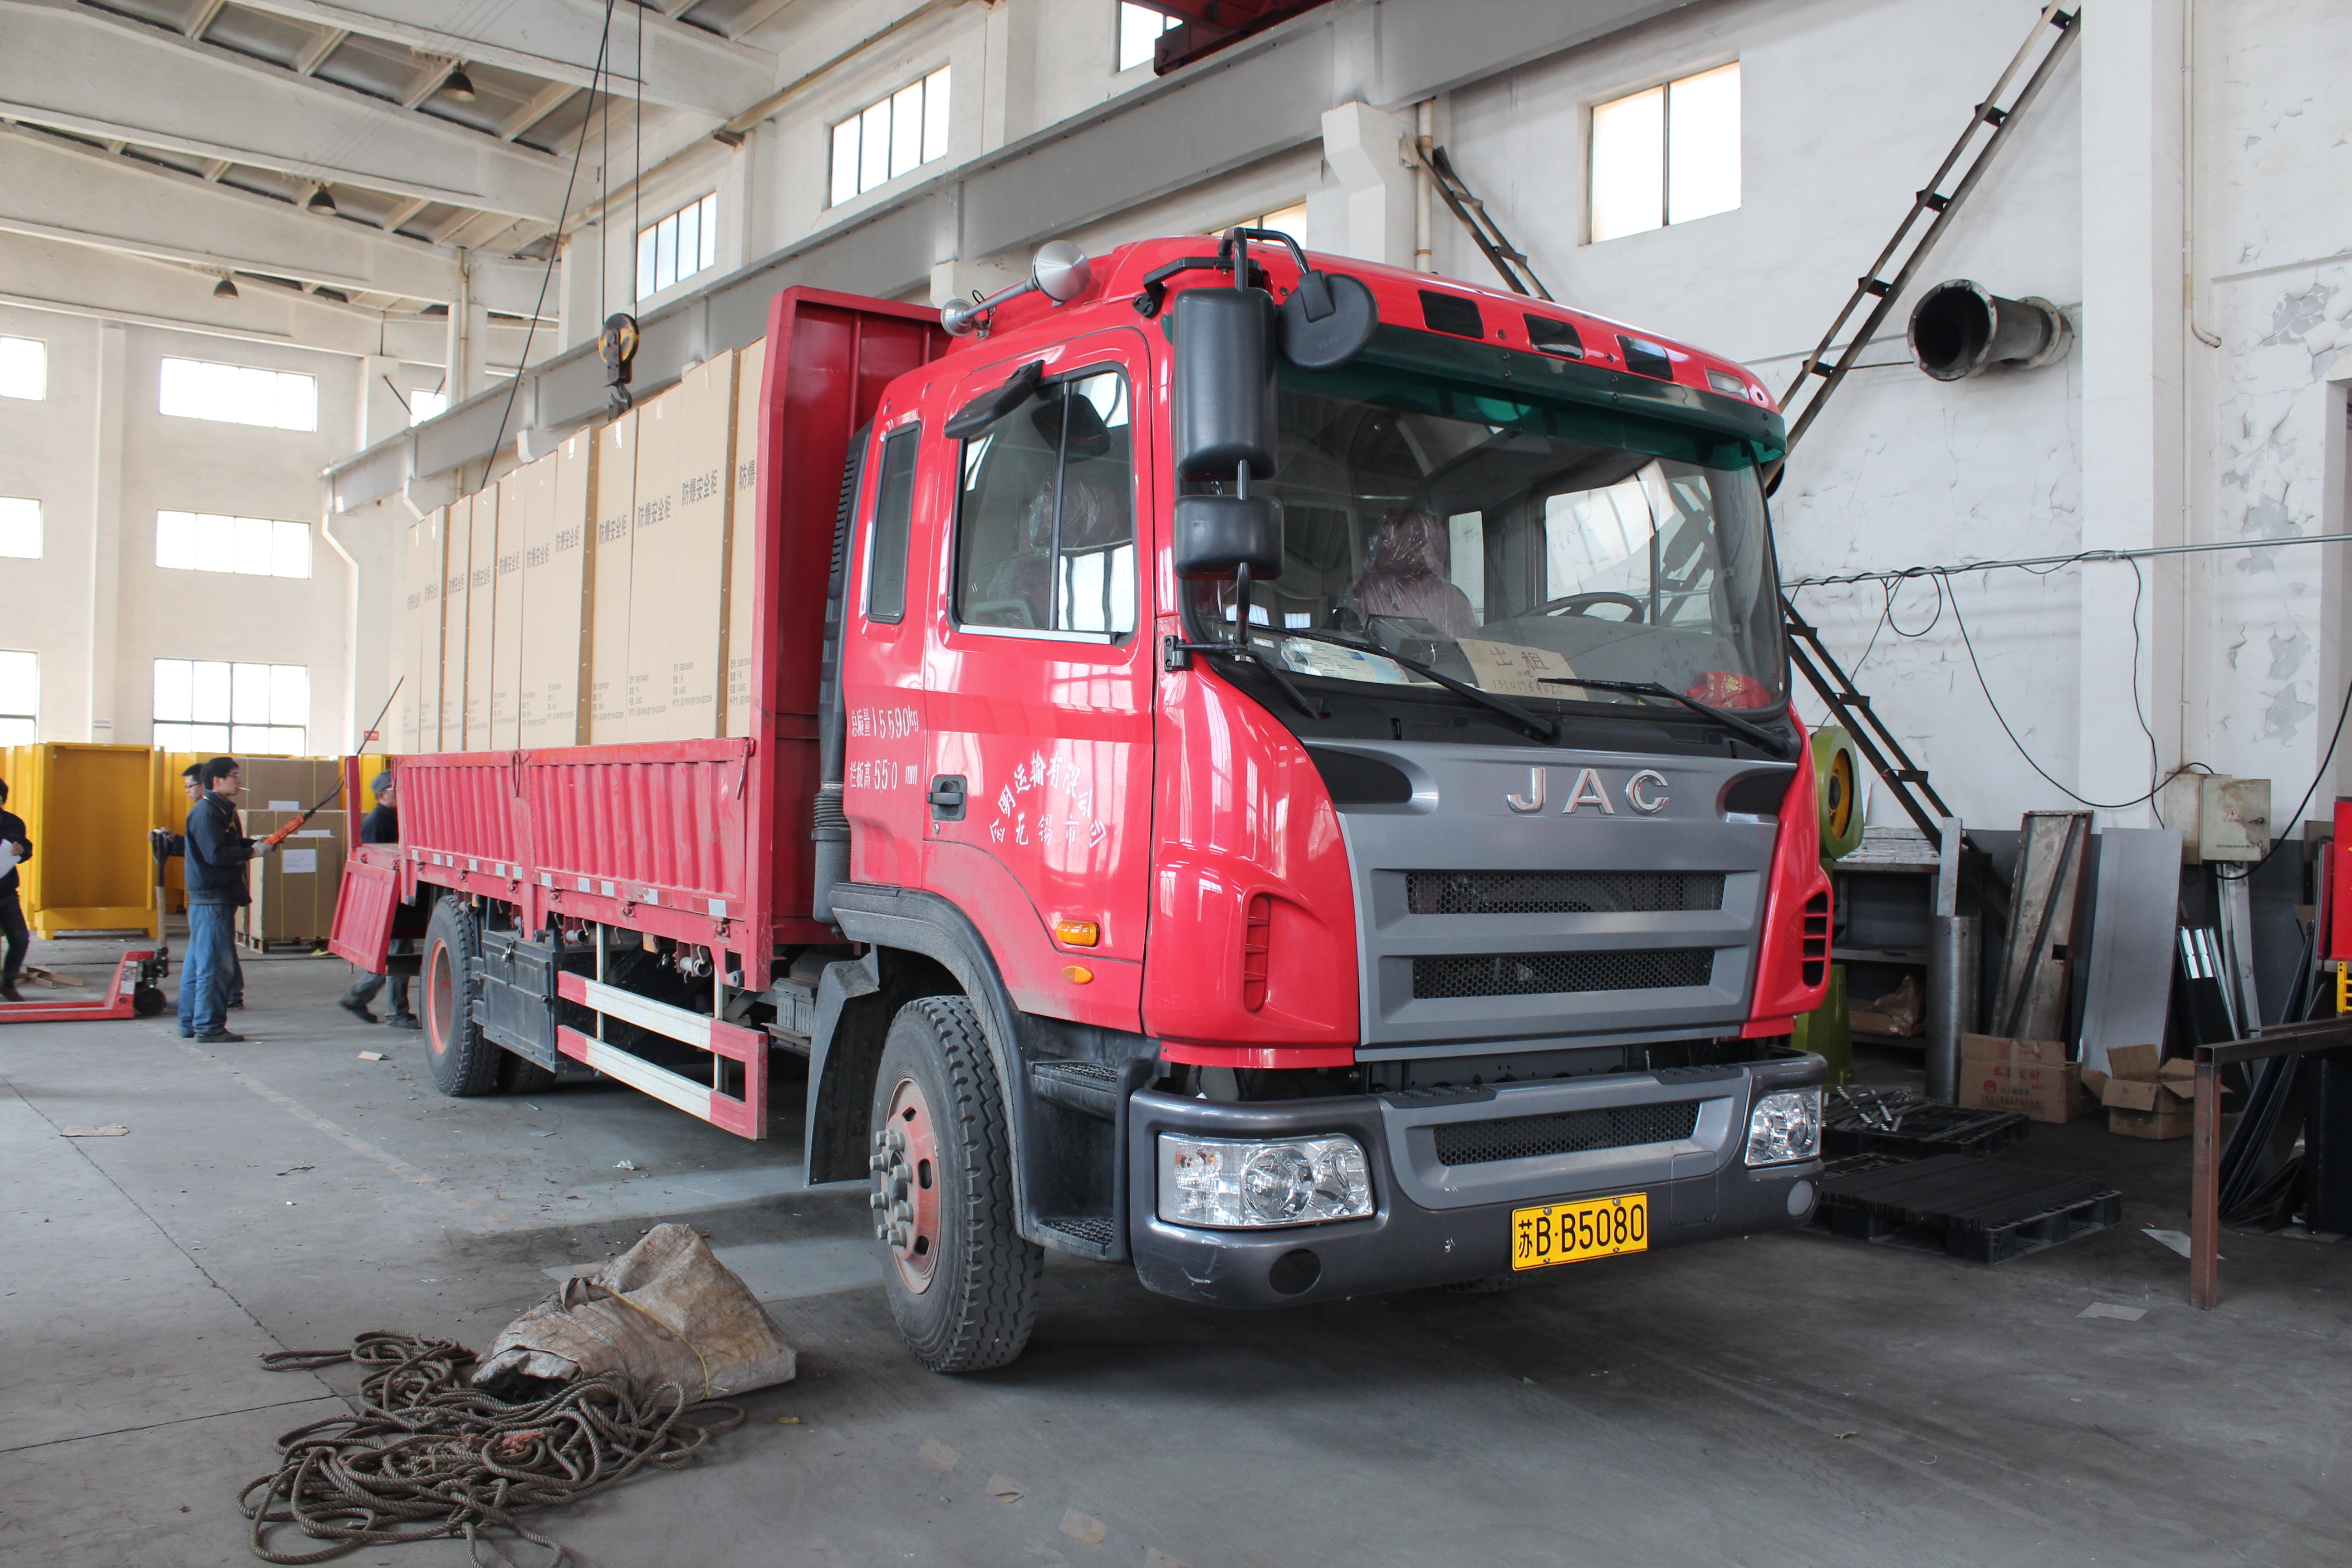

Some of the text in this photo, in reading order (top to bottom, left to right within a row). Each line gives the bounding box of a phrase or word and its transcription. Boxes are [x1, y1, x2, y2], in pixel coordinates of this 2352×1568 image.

[681, 469, 717, 507] 防爆安全柜
[637, 495, 671, 529] 防爆安全柜
[555, 525, 580, 554] 防爆安全柜
[598, 514, 627, 545] 防爆安全柜
[526, 543, 549, 569] 防爆安全柜
[1490, 647, 1550, 671] 出租
[1506, 767, 1670, 816] JAC
[1015, 812, 1080, 848] 无锡市
